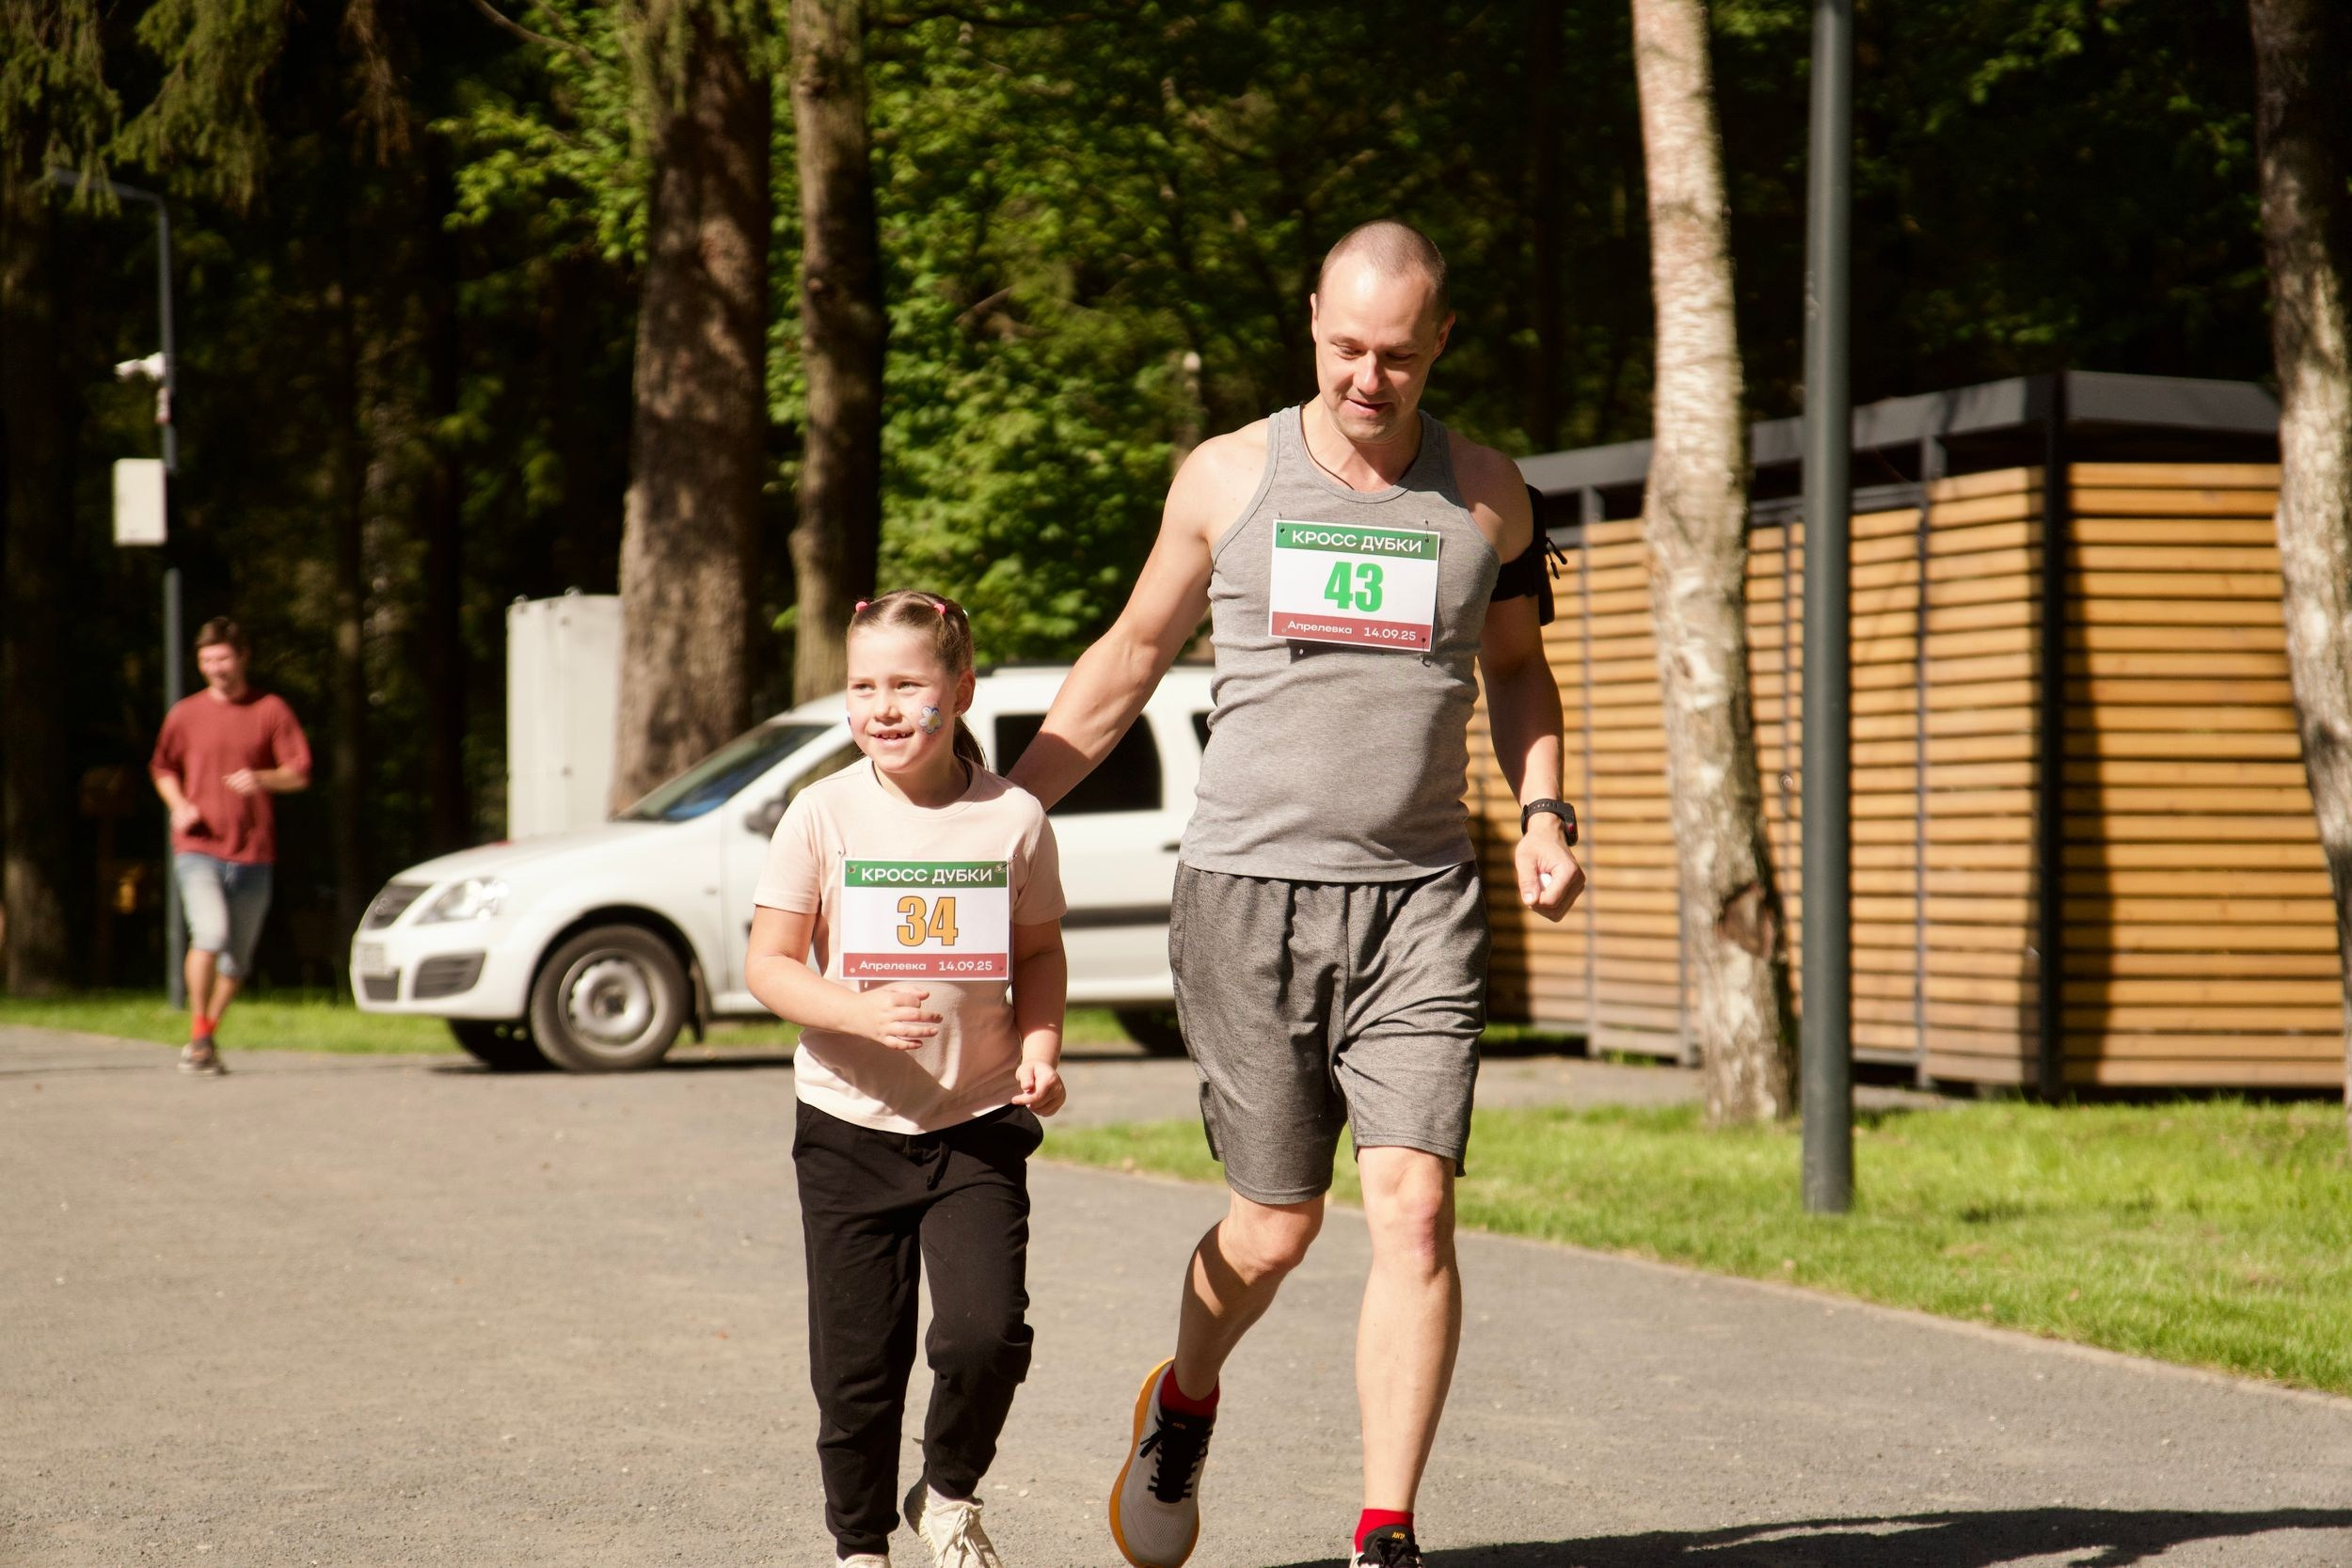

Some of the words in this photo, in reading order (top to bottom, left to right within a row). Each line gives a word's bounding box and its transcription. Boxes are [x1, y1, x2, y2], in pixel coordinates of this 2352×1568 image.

[1292, 531, 1357, 547] КРОСС
[1361, 536, 1422, 553] ДУБКИ
[1324, 561, 1384, 612] 43
[1287, 620, 1352, 634] Апрелевка
[1363, 627, 1416, 641] 14.09.25
[861, 867, 928, 882] КРОСС
[932, 868, 993, 884] ДУБКИ
[897, 895, 958, 946] 34
[859, 960, 926, 972] Апрелевка
[939, 961, 993, 971] 14.09.25
